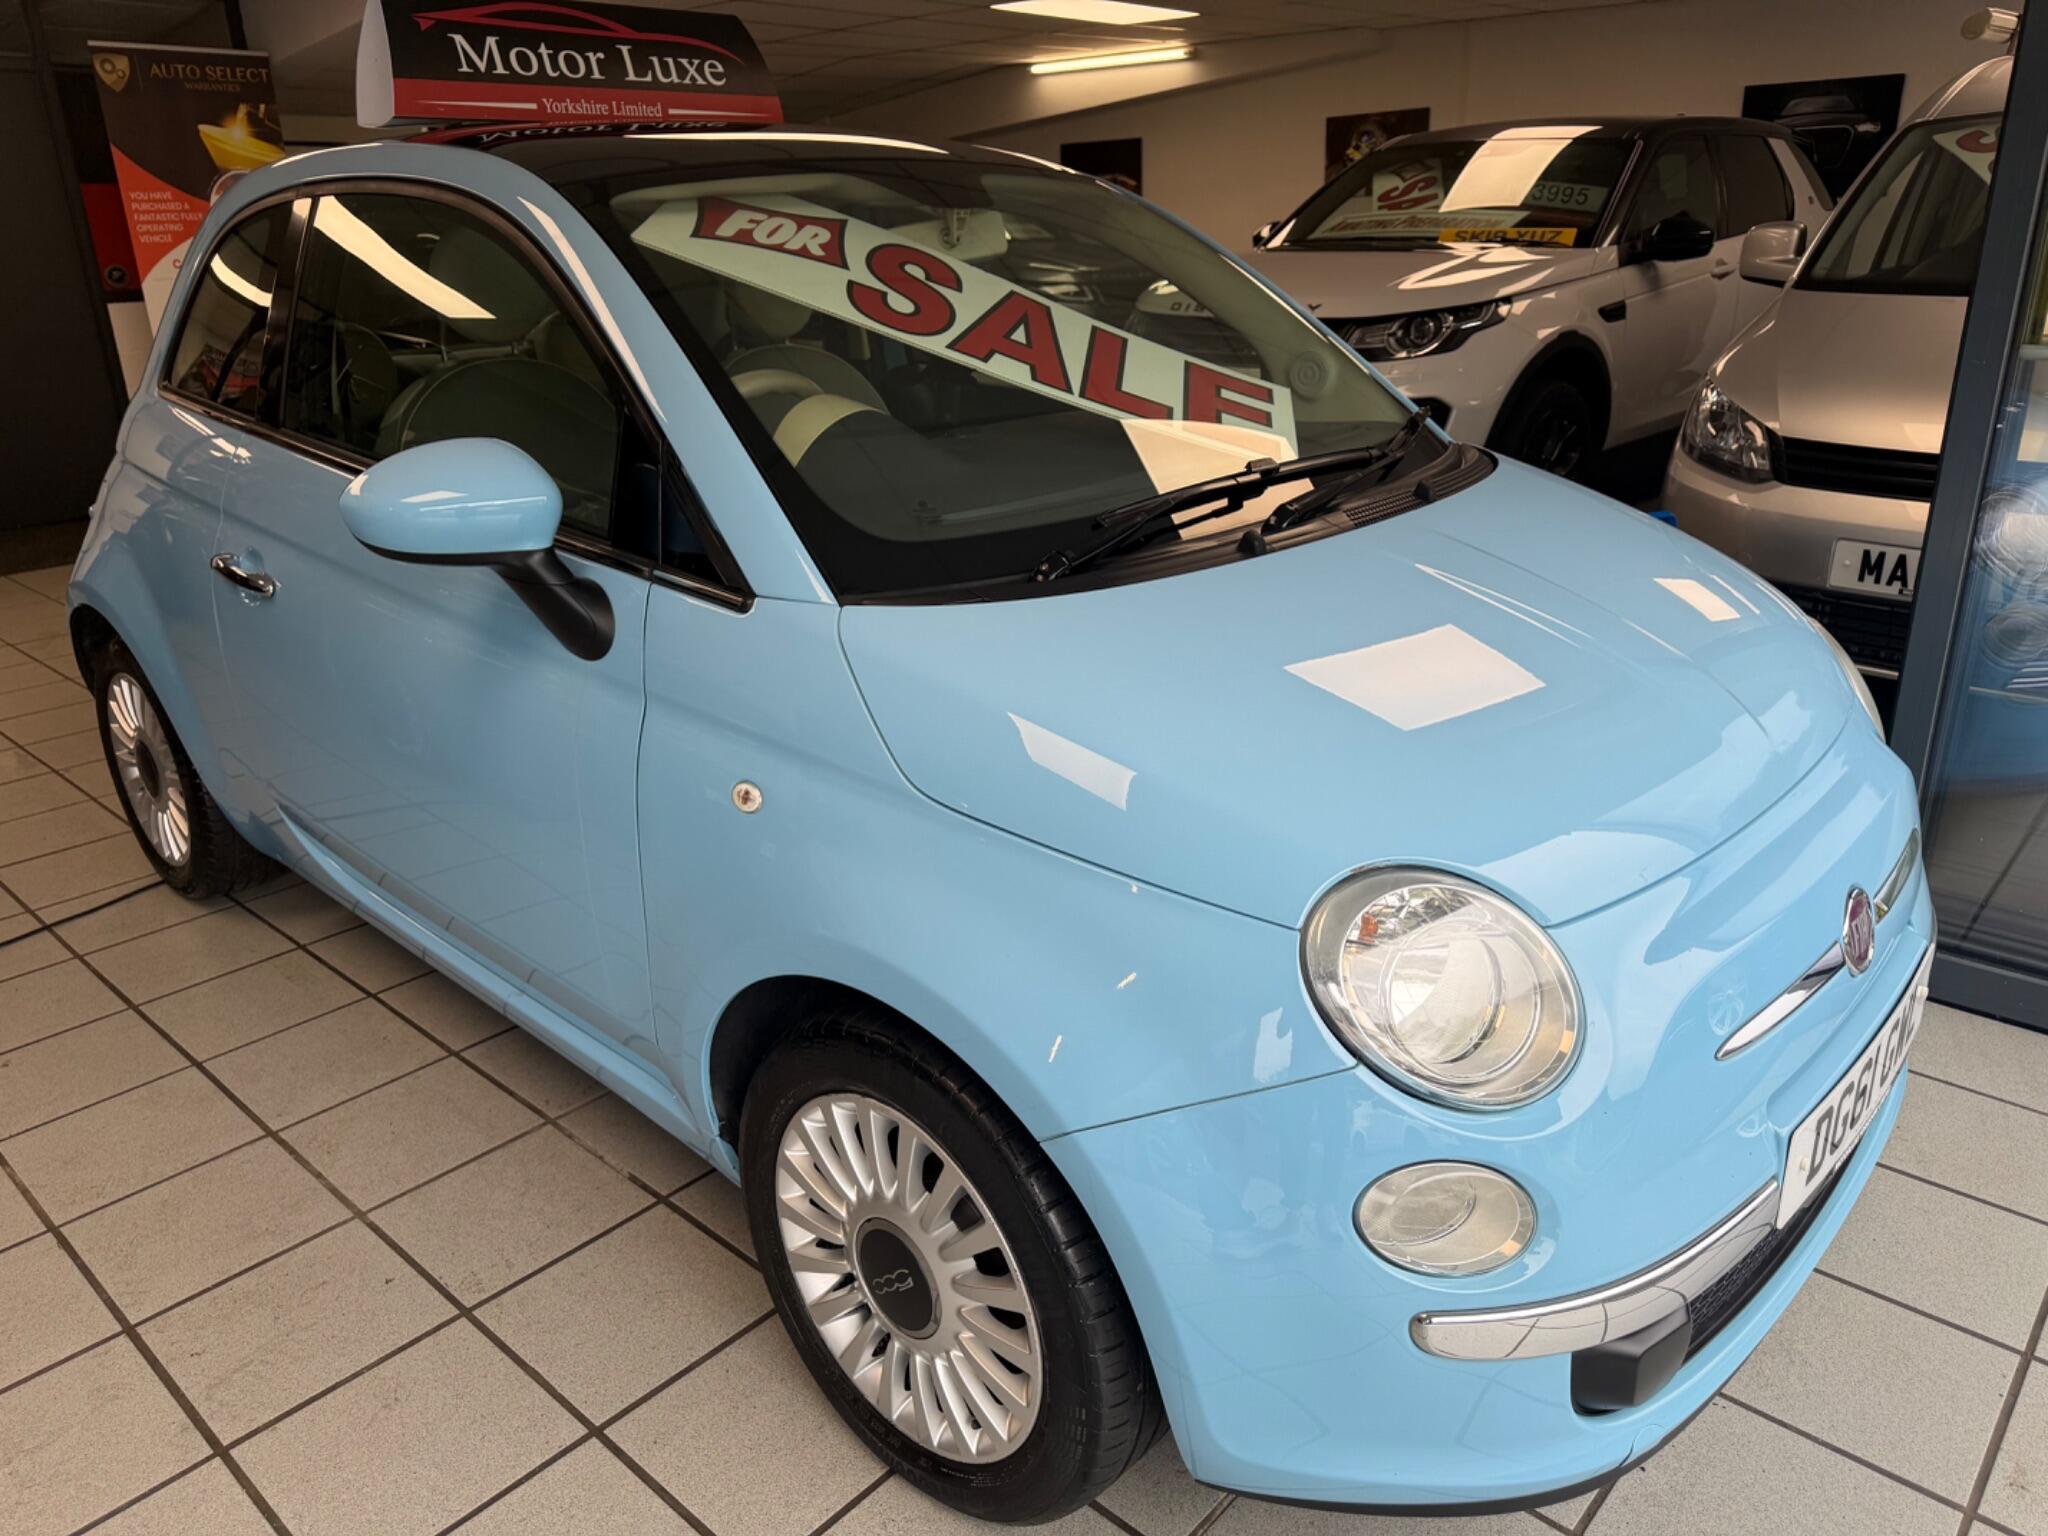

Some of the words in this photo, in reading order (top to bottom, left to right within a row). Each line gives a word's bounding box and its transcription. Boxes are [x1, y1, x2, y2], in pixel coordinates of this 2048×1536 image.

[447, 33, 605, 80] Motor
[615, 45, 727, 86] Luxe
[150, 63, 200, 79] AUTO
[205, 66, 269, 83] SELECT
[542, 98, 609, 116] Yorkshire
[611, 101, 662, 118] Limited
[129, 192, 148, 200] YOU
[149, 192, 172, 200] HAVE
[132, 203, 183, 211] PURCHASED
[136, 223, 184, 232] OPERATING
[714, 207, 833, 257] FOR
[139, 234, 173, 243] VEHICLE
[846, 241, 1275, 434] SALE
[1805, 1045, 1881, 1187] DG61
